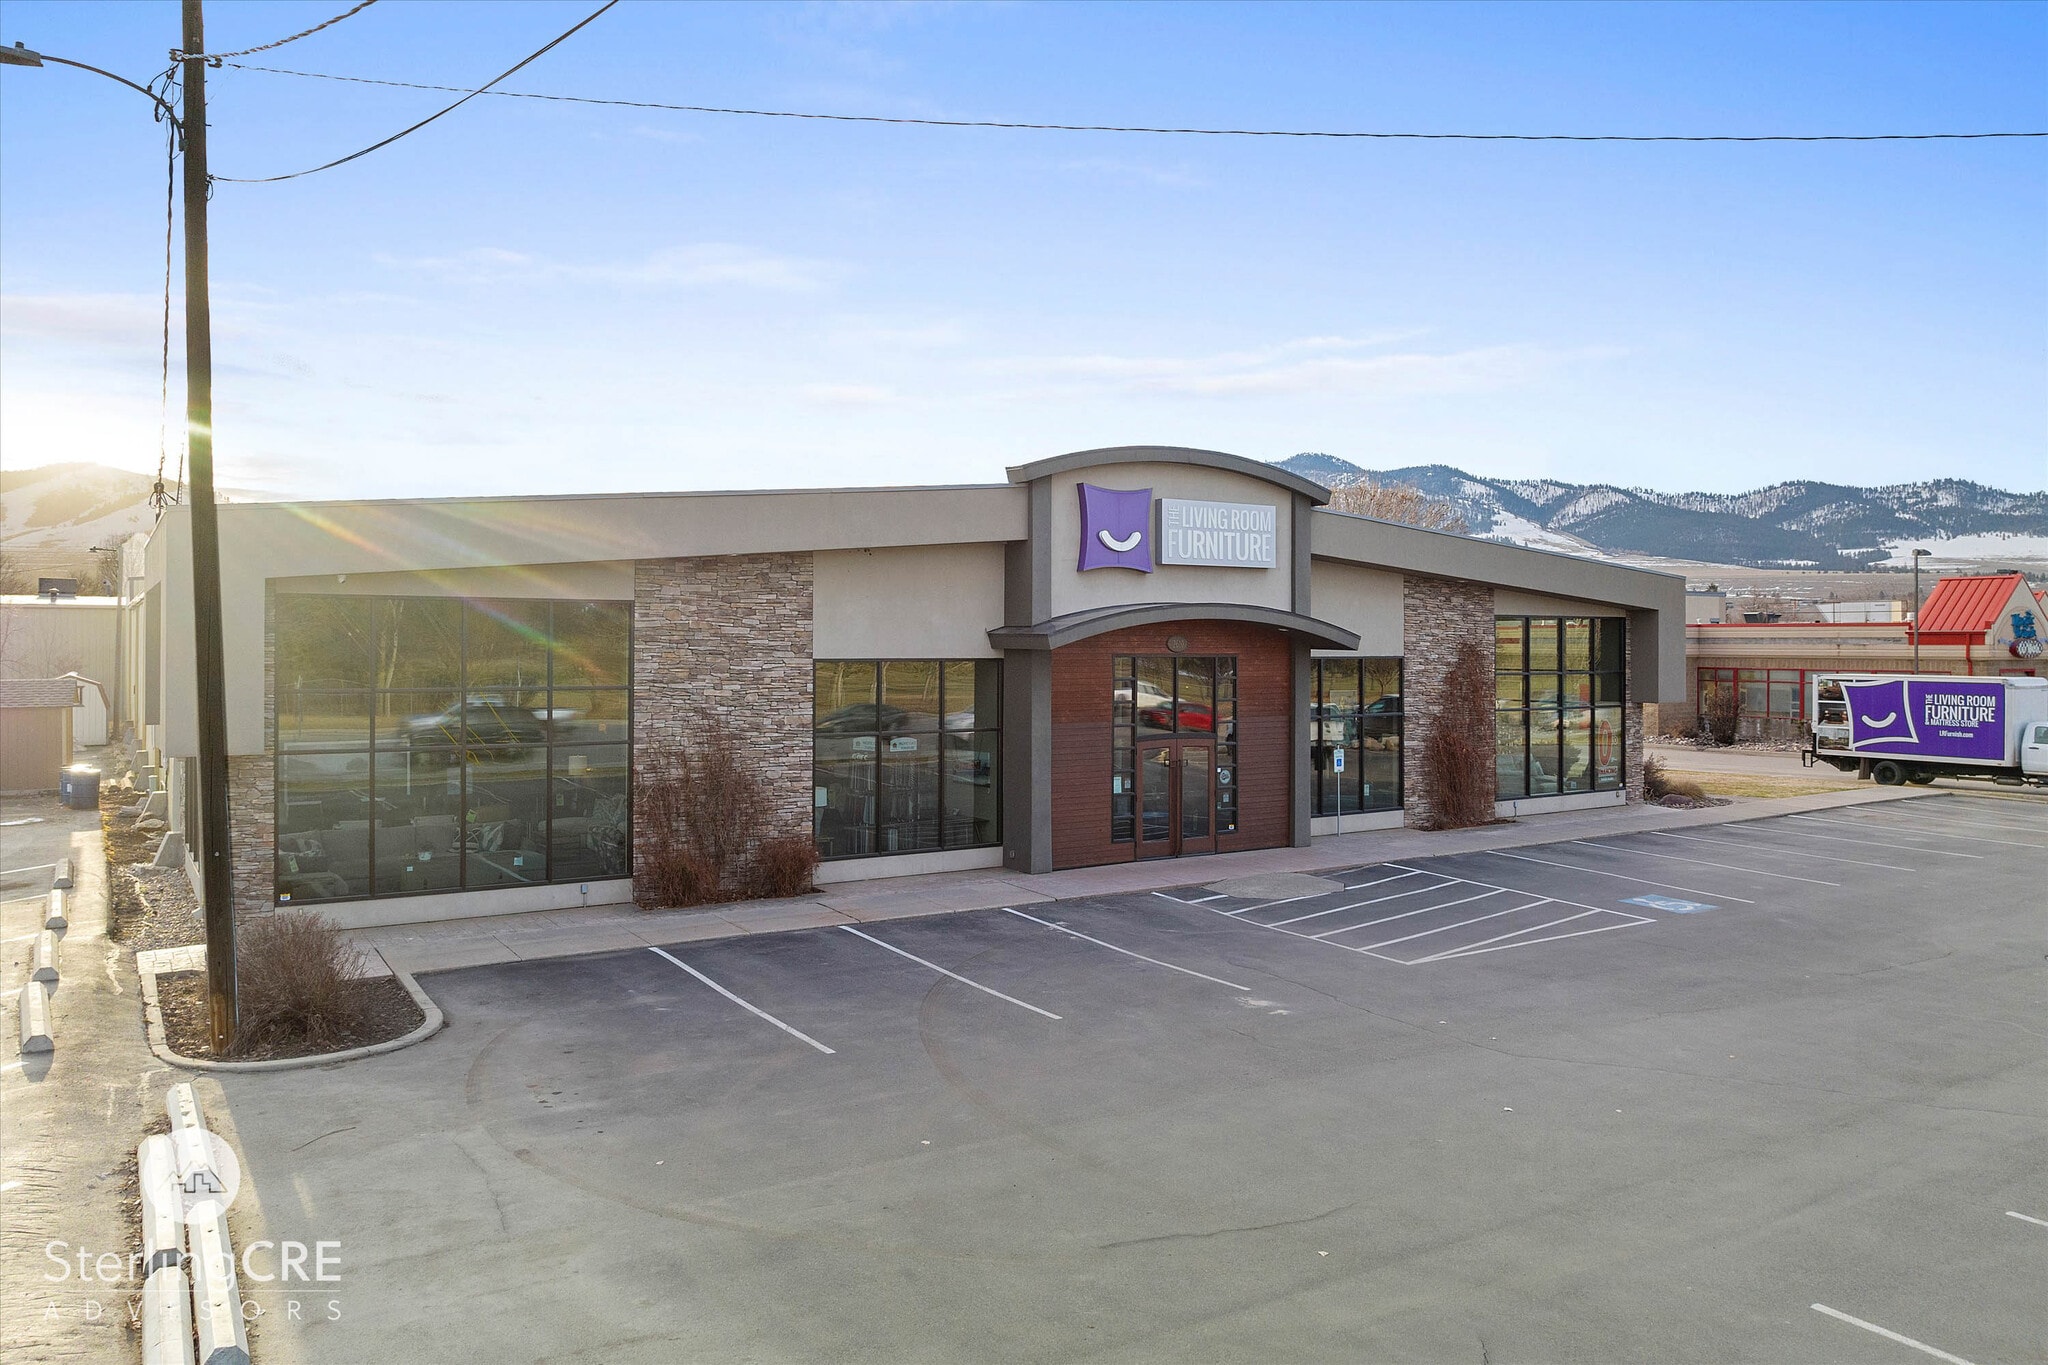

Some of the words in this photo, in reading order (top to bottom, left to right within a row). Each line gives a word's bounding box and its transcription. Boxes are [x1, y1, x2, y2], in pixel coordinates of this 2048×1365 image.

[1168, 505, 1180, 526] THE
[1182, 506, 1228, 530] LIVING
[1231, 509, 1272, 532] ROOM
[1168, 529, 1272, 562] FURNITURE
[1934, 694, 1965, 706] LIVING
[1966, 695, 1996, 707] ROOM
[1925, 705, 1996, 722] FURNITURE
[1930, 719, 1960, 727] MATTRESS
[1960, 720, 1979, 728] STORE
